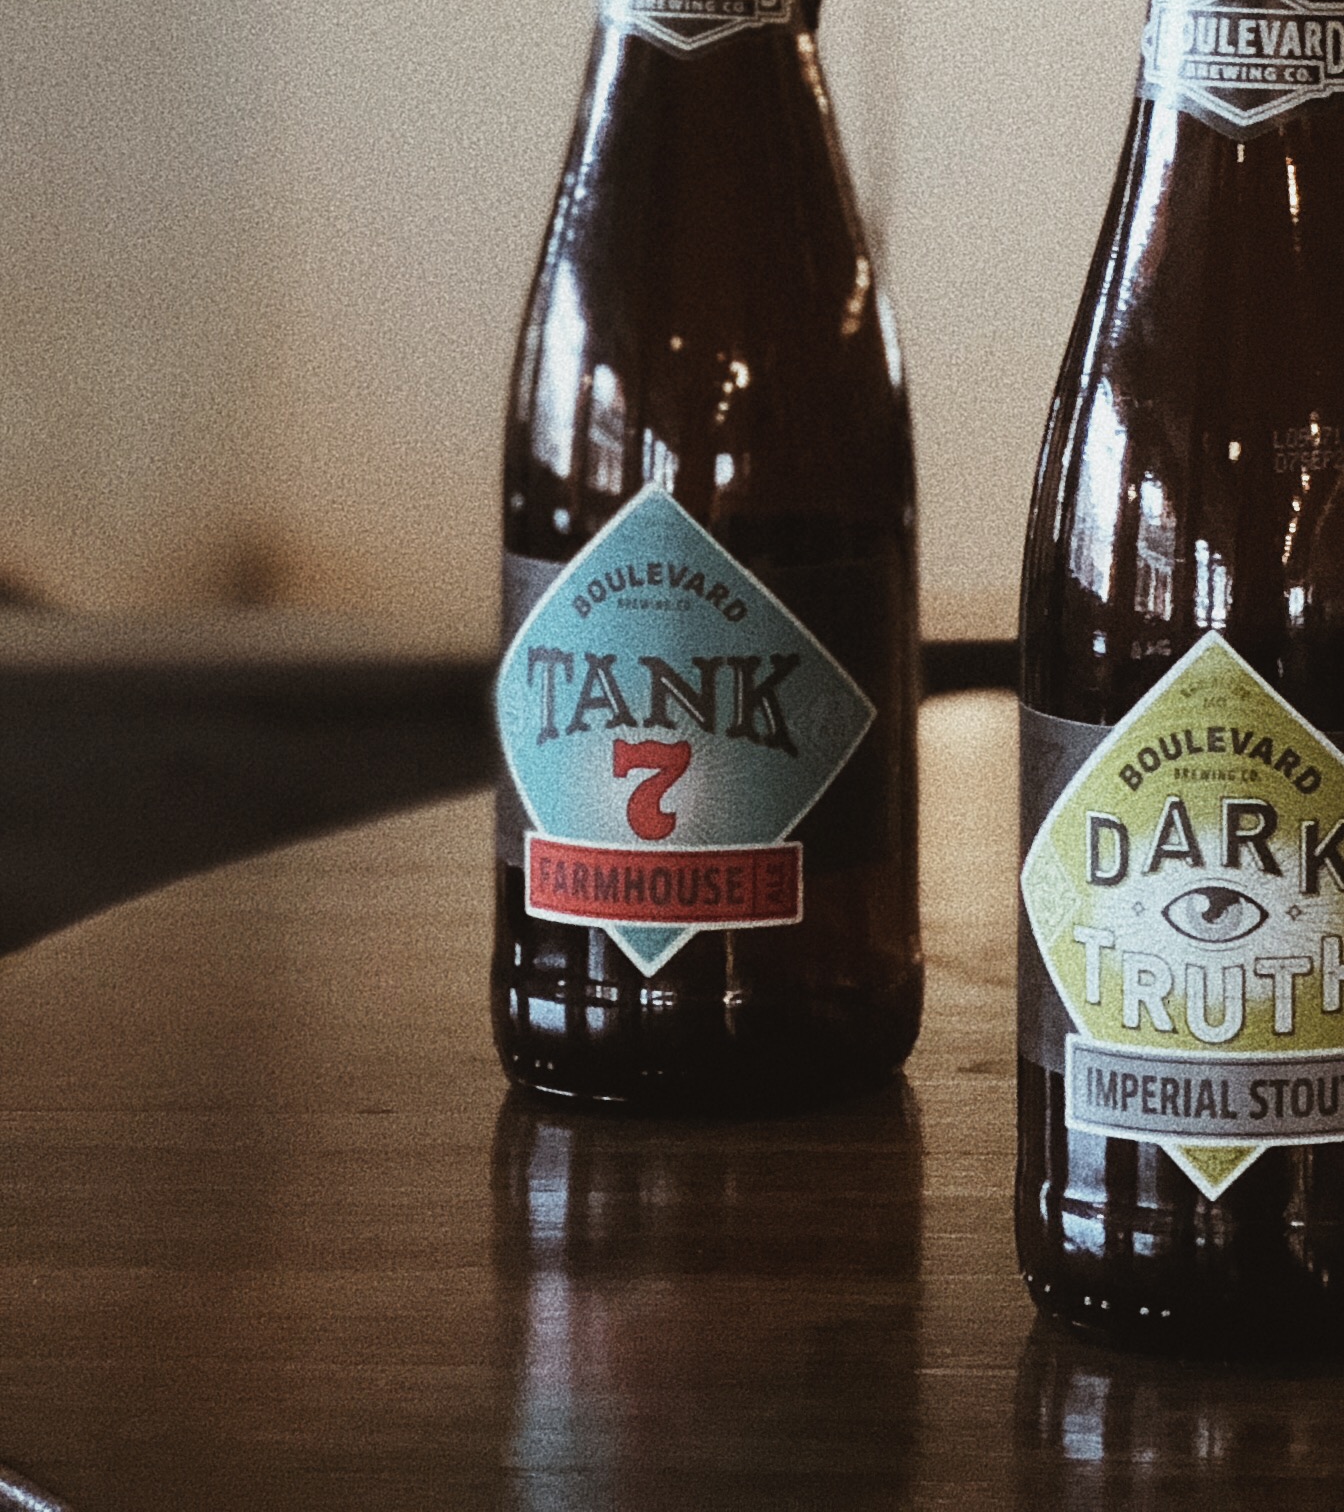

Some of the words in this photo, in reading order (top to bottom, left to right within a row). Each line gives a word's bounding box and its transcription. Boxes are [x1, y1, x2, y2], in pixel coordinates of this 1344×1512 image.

[573, 562, 748, 624] BOULEVARD
[527, 645, 801, 757] TANK
[613, 739, 691, 841] 7
[1119, 726, 1322, 796] BOULEVARD
[539, 856, 745, 907] FARMHOUSE
[1085, 1066, 1238, 1120] IMPERIAL
